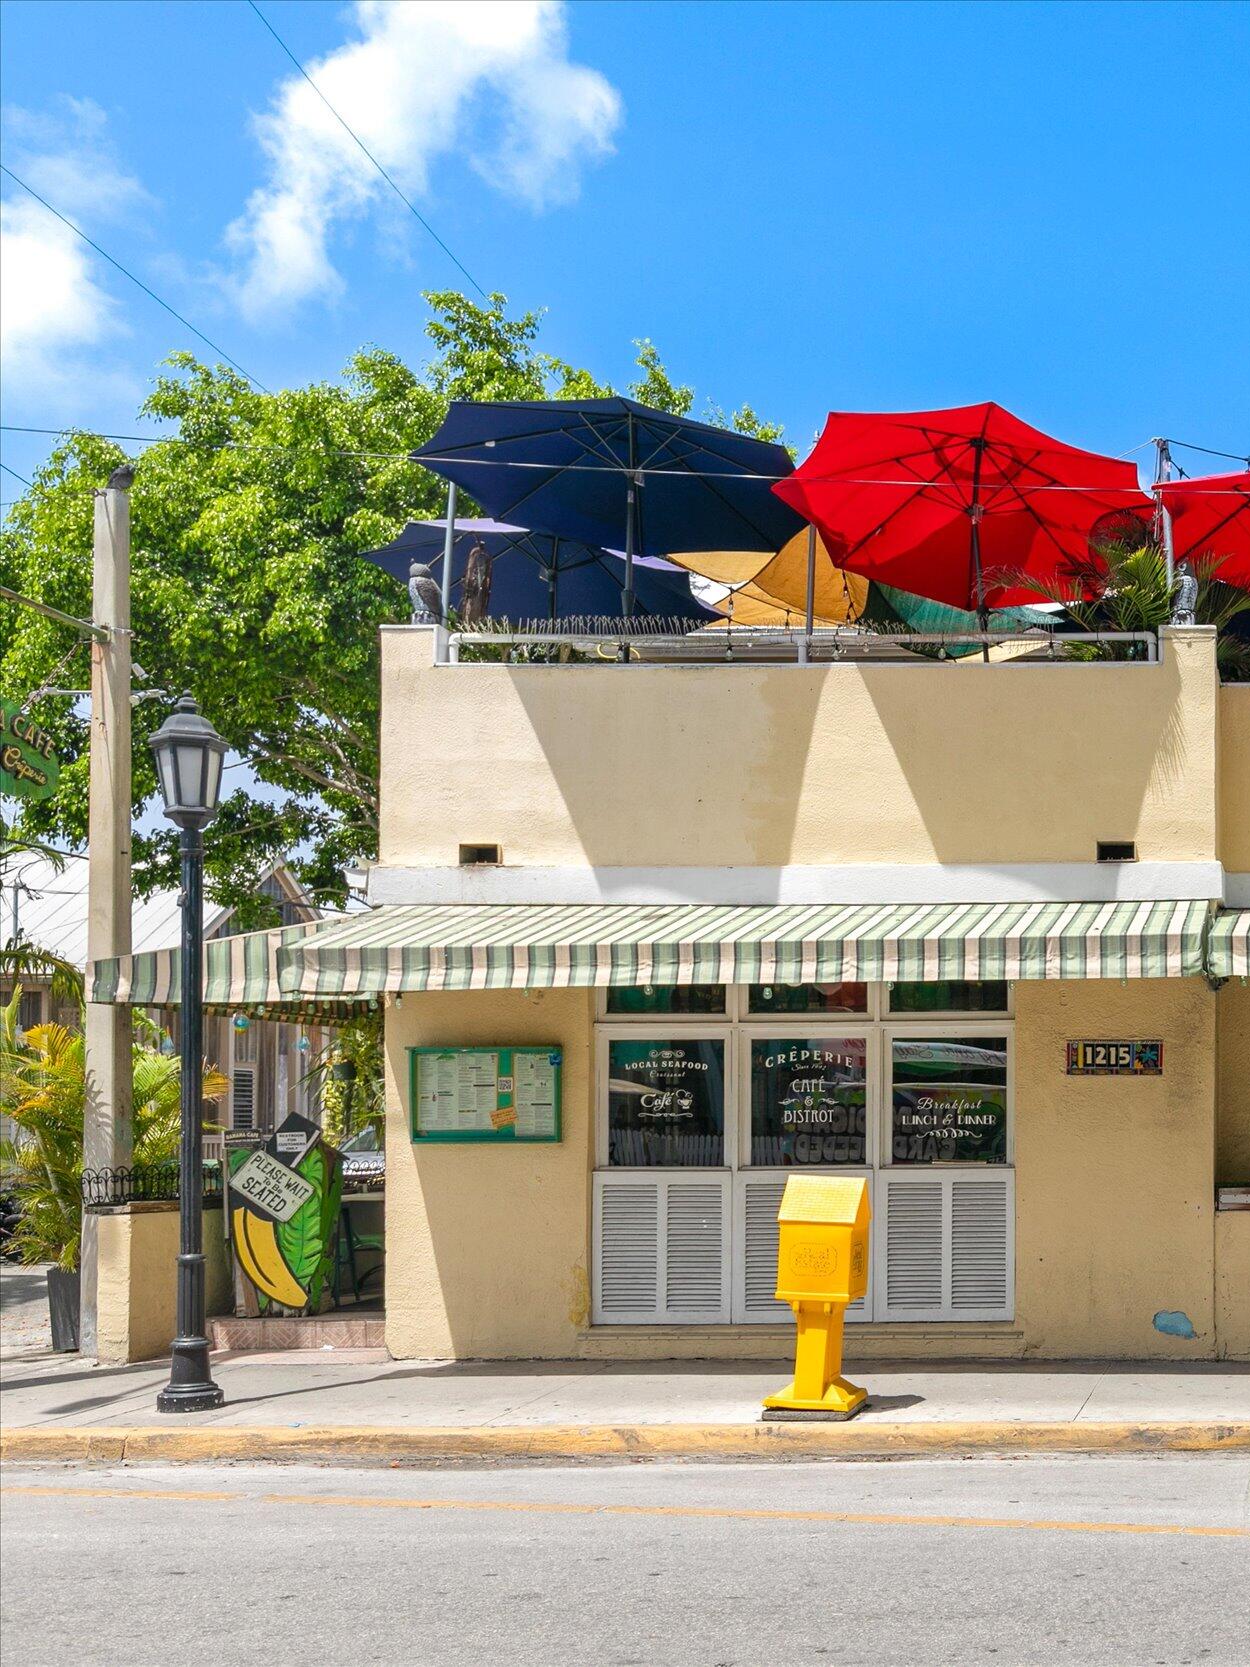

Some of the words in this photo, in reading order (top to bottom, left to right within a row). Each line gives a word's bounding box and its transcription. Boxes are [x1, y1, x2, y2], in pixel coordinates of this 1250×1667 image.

[765, 1045, 853, 1068] CRÊPERIE
[1085, 1046, 1131, 1064] 1215
[625, 1061, 658, 1070] LOCAL
[661, 1061, 708, 1070] SEAFOOD
[792, 1075, 826, 1092] CAFÉ
[641, 1091, 675, 1111] Café
[804, 1095, 813, 1106] &
[917, 1097, 982, 1113] Breakfast
[784, 1109, 834, 1123] BISTROT
[902, 1115, 937, 1125] LUNCH
[942, 1114, 954, 1125] &
[957, 1115, 997, 1125] DINNER
[250, 1155, 287, 1184] PLEASE
[284, 1177, 310, 1200] WAIT
[262, 1176, 272, 1187] To
[242, 1177, 287, 1213] SEATED
